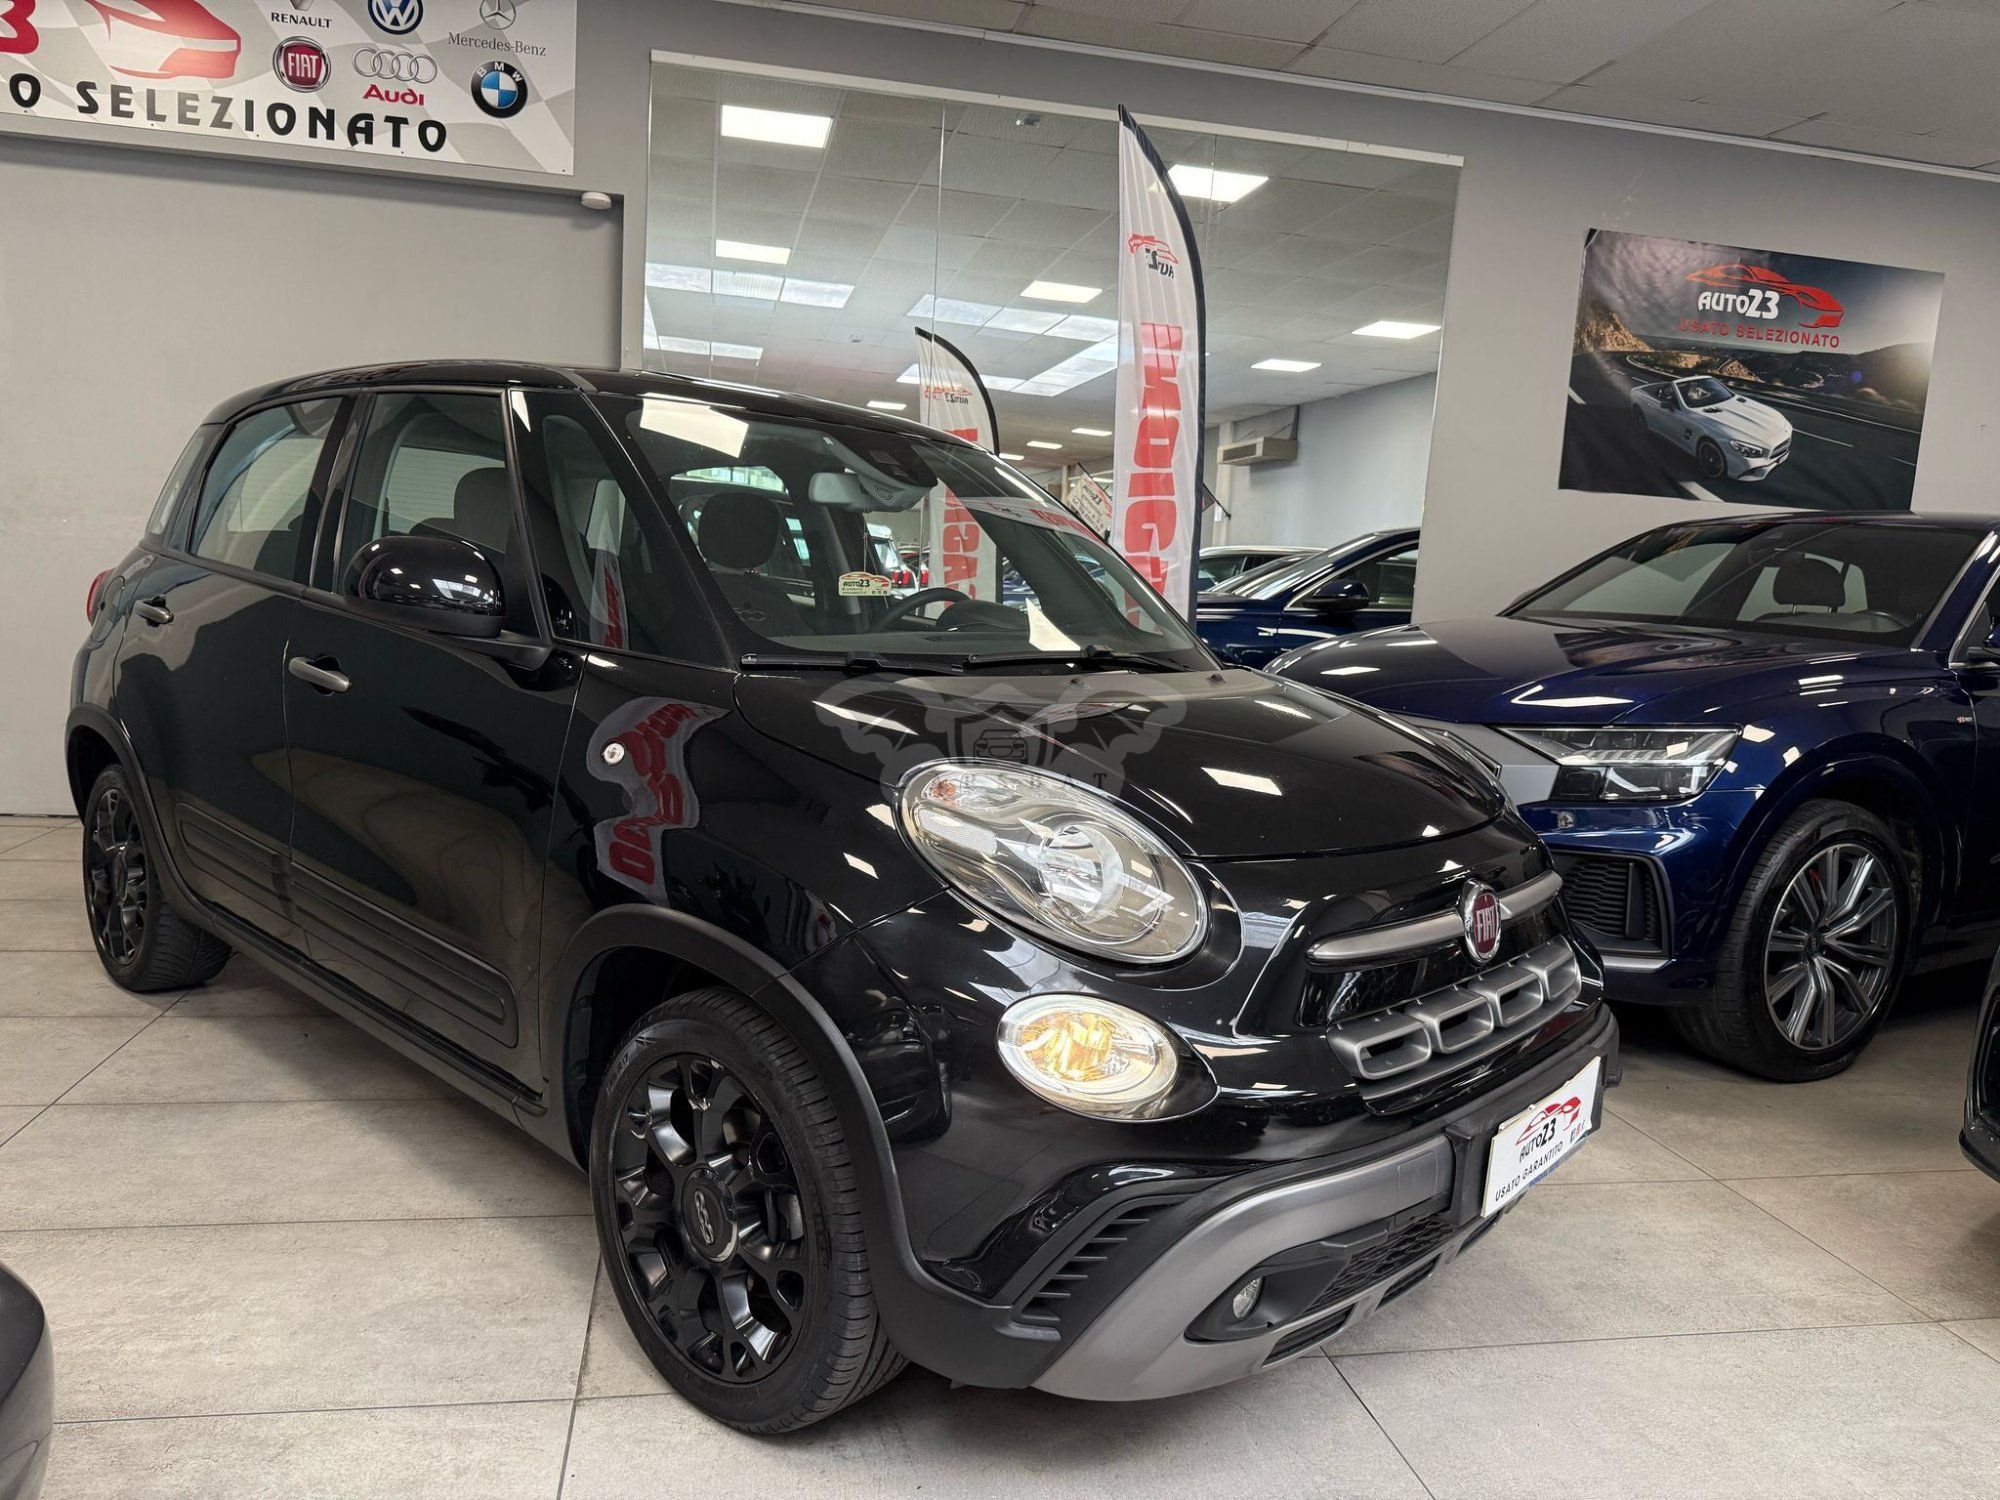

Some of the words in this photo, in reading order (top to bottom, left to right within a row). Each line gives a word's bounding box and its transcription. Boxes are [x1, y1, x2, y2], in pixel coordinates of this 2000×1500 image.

[271, 12, 332, 29] RENAULT
[448, 32, 547, 56] Mercedes-Benz
[287, 53, 319, 79] FIAT
[476, 62, 523, 83] BMW
[363, 84, 425, 106] Audi
[76, 80, 447, 153] SELEZIONATO
[1697, 288, 1780, 320] AUTO23
[1680, 317, 1732, 337] USATO
[1736, 323, 1841, 349] SELEZIONATO
[1475, 905, 1496, 943] FIAT
[1519, 1118, 1557, 1163] AUTO23
[1495, 1175, 1521, 1202] USATO
[1522, 1141, 1564, 1181] GARANTITO
